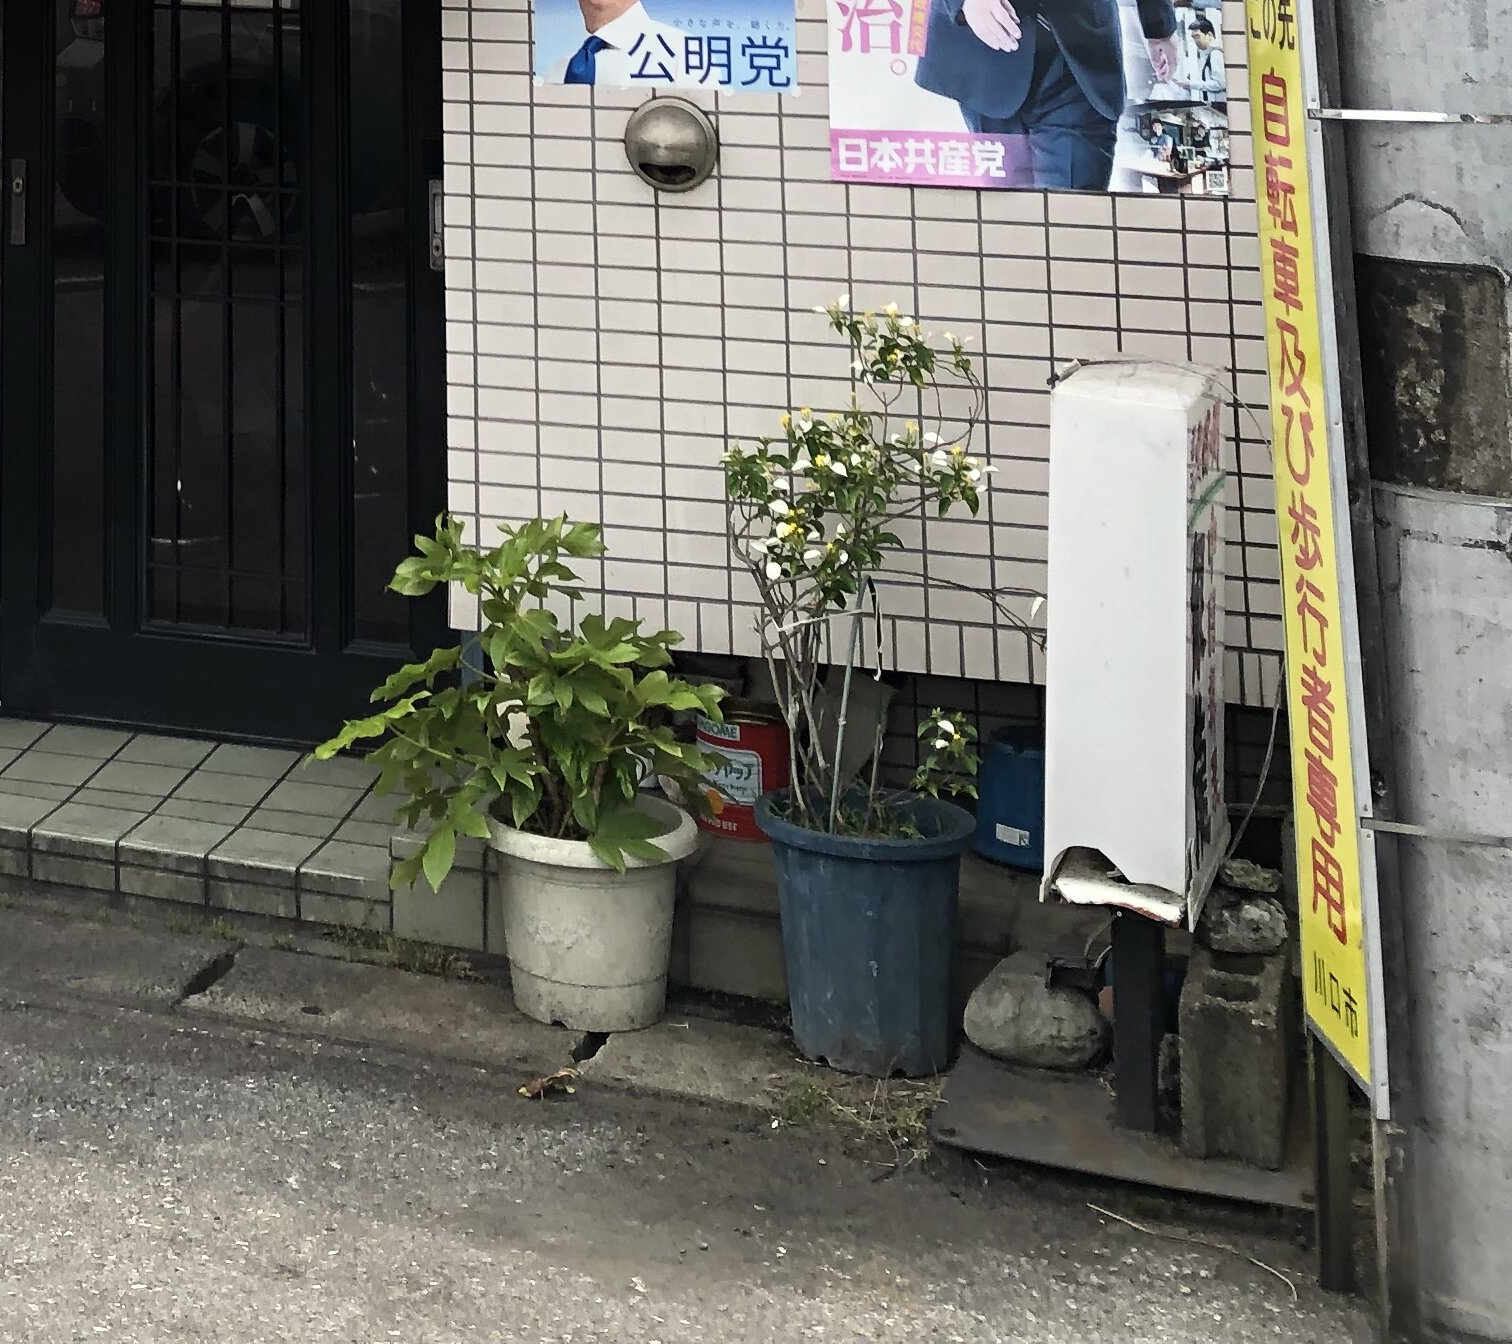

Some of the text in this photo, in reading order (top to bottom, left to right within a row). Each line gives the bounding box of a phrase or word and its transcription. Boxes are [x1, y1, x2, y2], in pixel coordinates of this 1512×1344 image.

[628, 32, 791, 87] 公明党
[838, 138, 1007, 179] 日本共産党
[1260, 66, 1349, 945] 自転車及び歩行者専用
[1313, 950, 1359, 1038] 川口市
